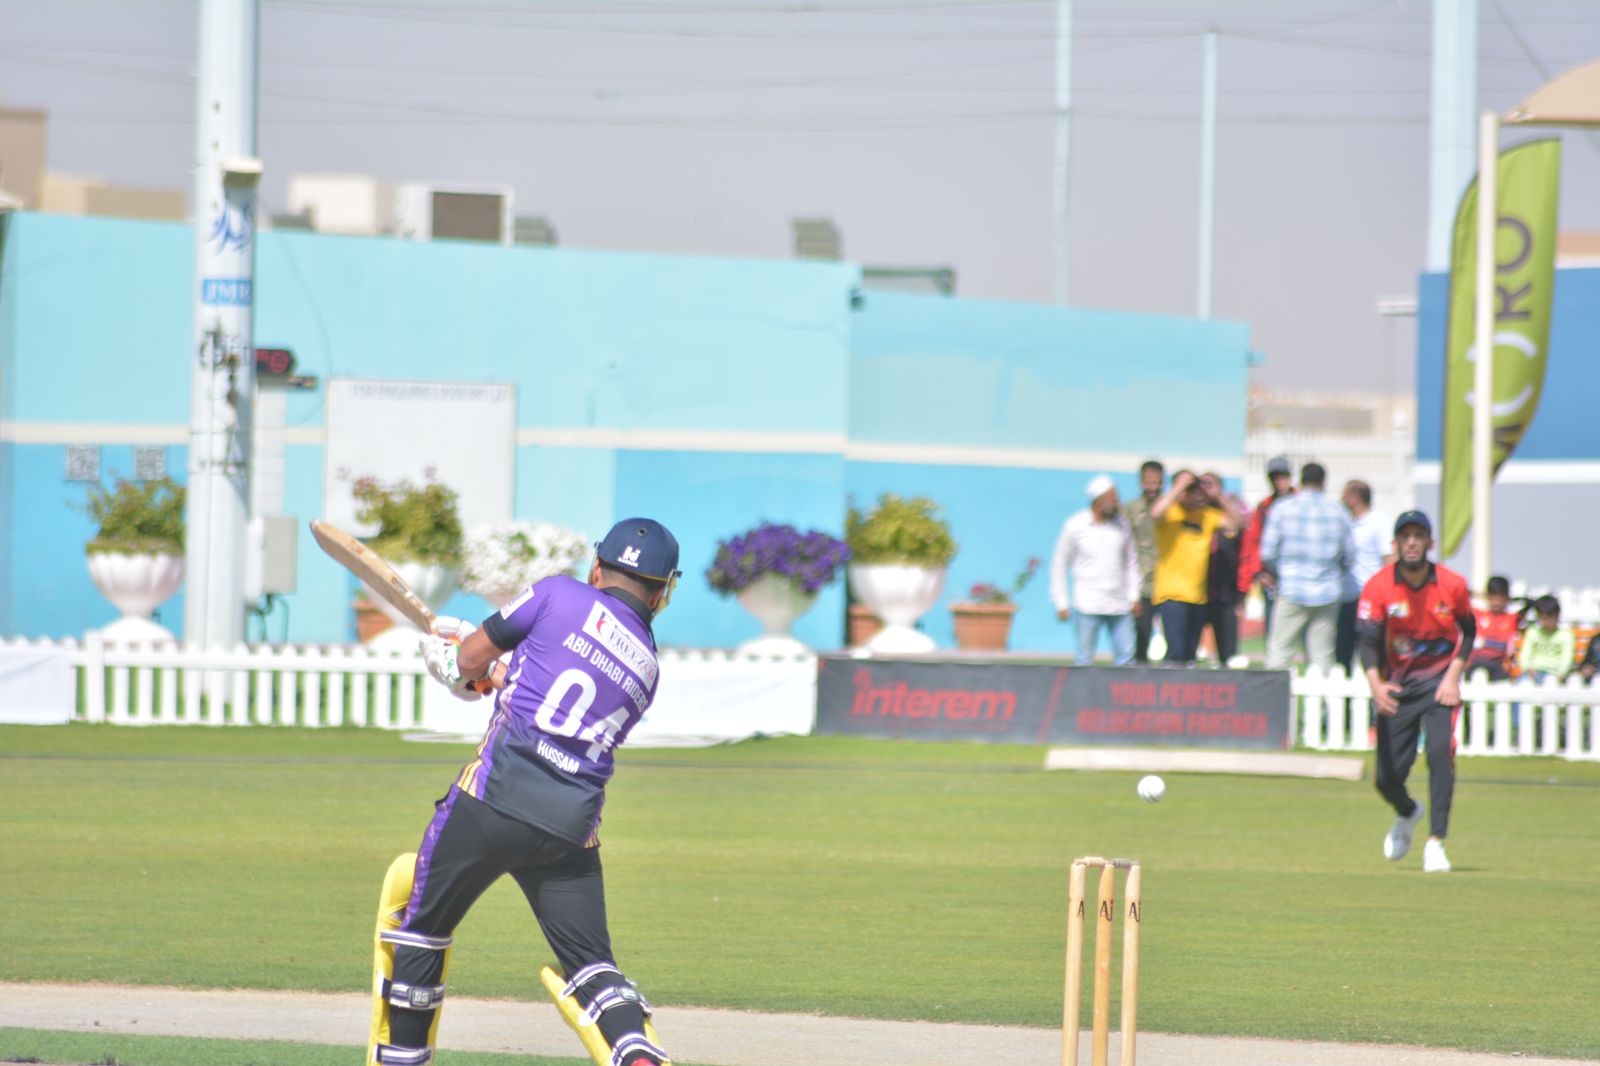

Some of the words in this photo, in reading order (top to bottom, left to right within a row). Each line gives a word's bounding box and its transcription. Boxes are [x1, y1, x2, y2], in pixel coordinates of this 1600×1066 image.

[562, 632, 593, 659] ABU
[589, 648, 625, 685] DHABI
[622, 675, 648, 712] RIDERS
[851, 667, 1018, 720] interem
[534, 668, 630, 763] 04
[537, 740, 580, 775] HUSSAM
